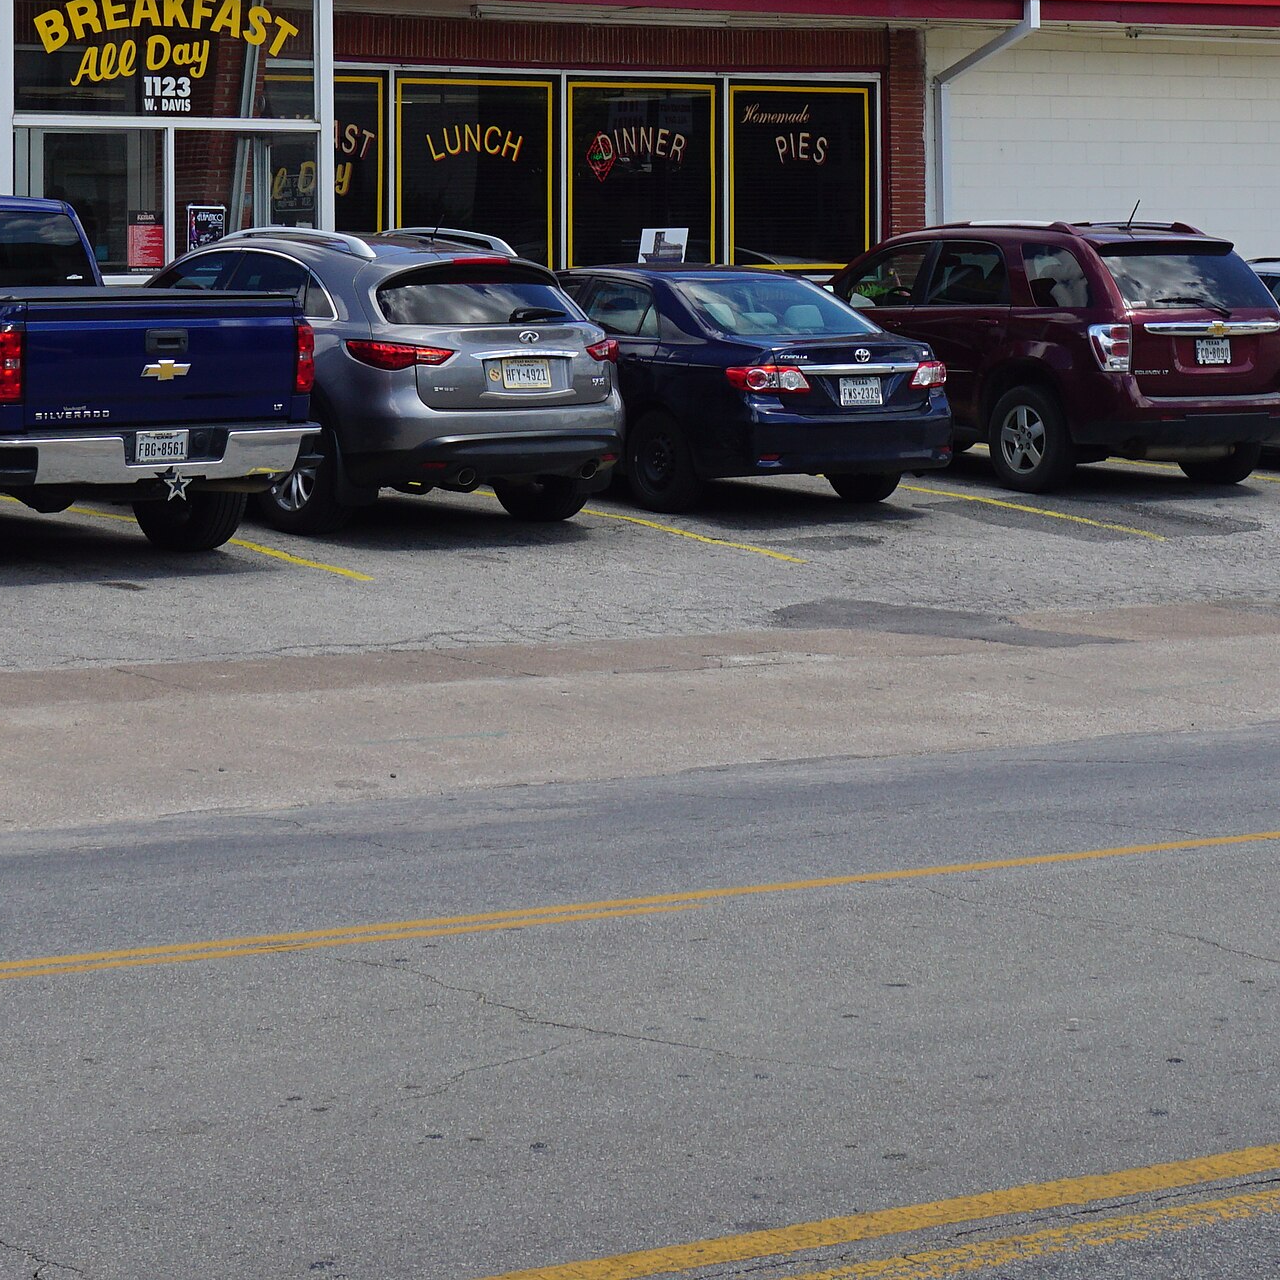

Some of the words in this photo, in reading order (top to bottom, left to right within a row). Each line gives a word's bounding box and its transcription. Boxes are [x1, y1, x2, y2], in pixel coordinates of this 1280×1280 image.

[70, 39, 137, 87] All
[146, 34, 210, 79] Day
[144, 76, 191, 97] 1123
[144, 98, 158, 112] W.
[162, 98, 191, 112] DAVIS
[740, 103, 810, 124] Homemade
[426, 123, 523, 162] LUNCH
[597, 126, 687, 163] DINNER
[775, 132, 828, 165] PIES
[35, 410, 110, 420] SILVERADO
[273, 403, 283, 411] LT
